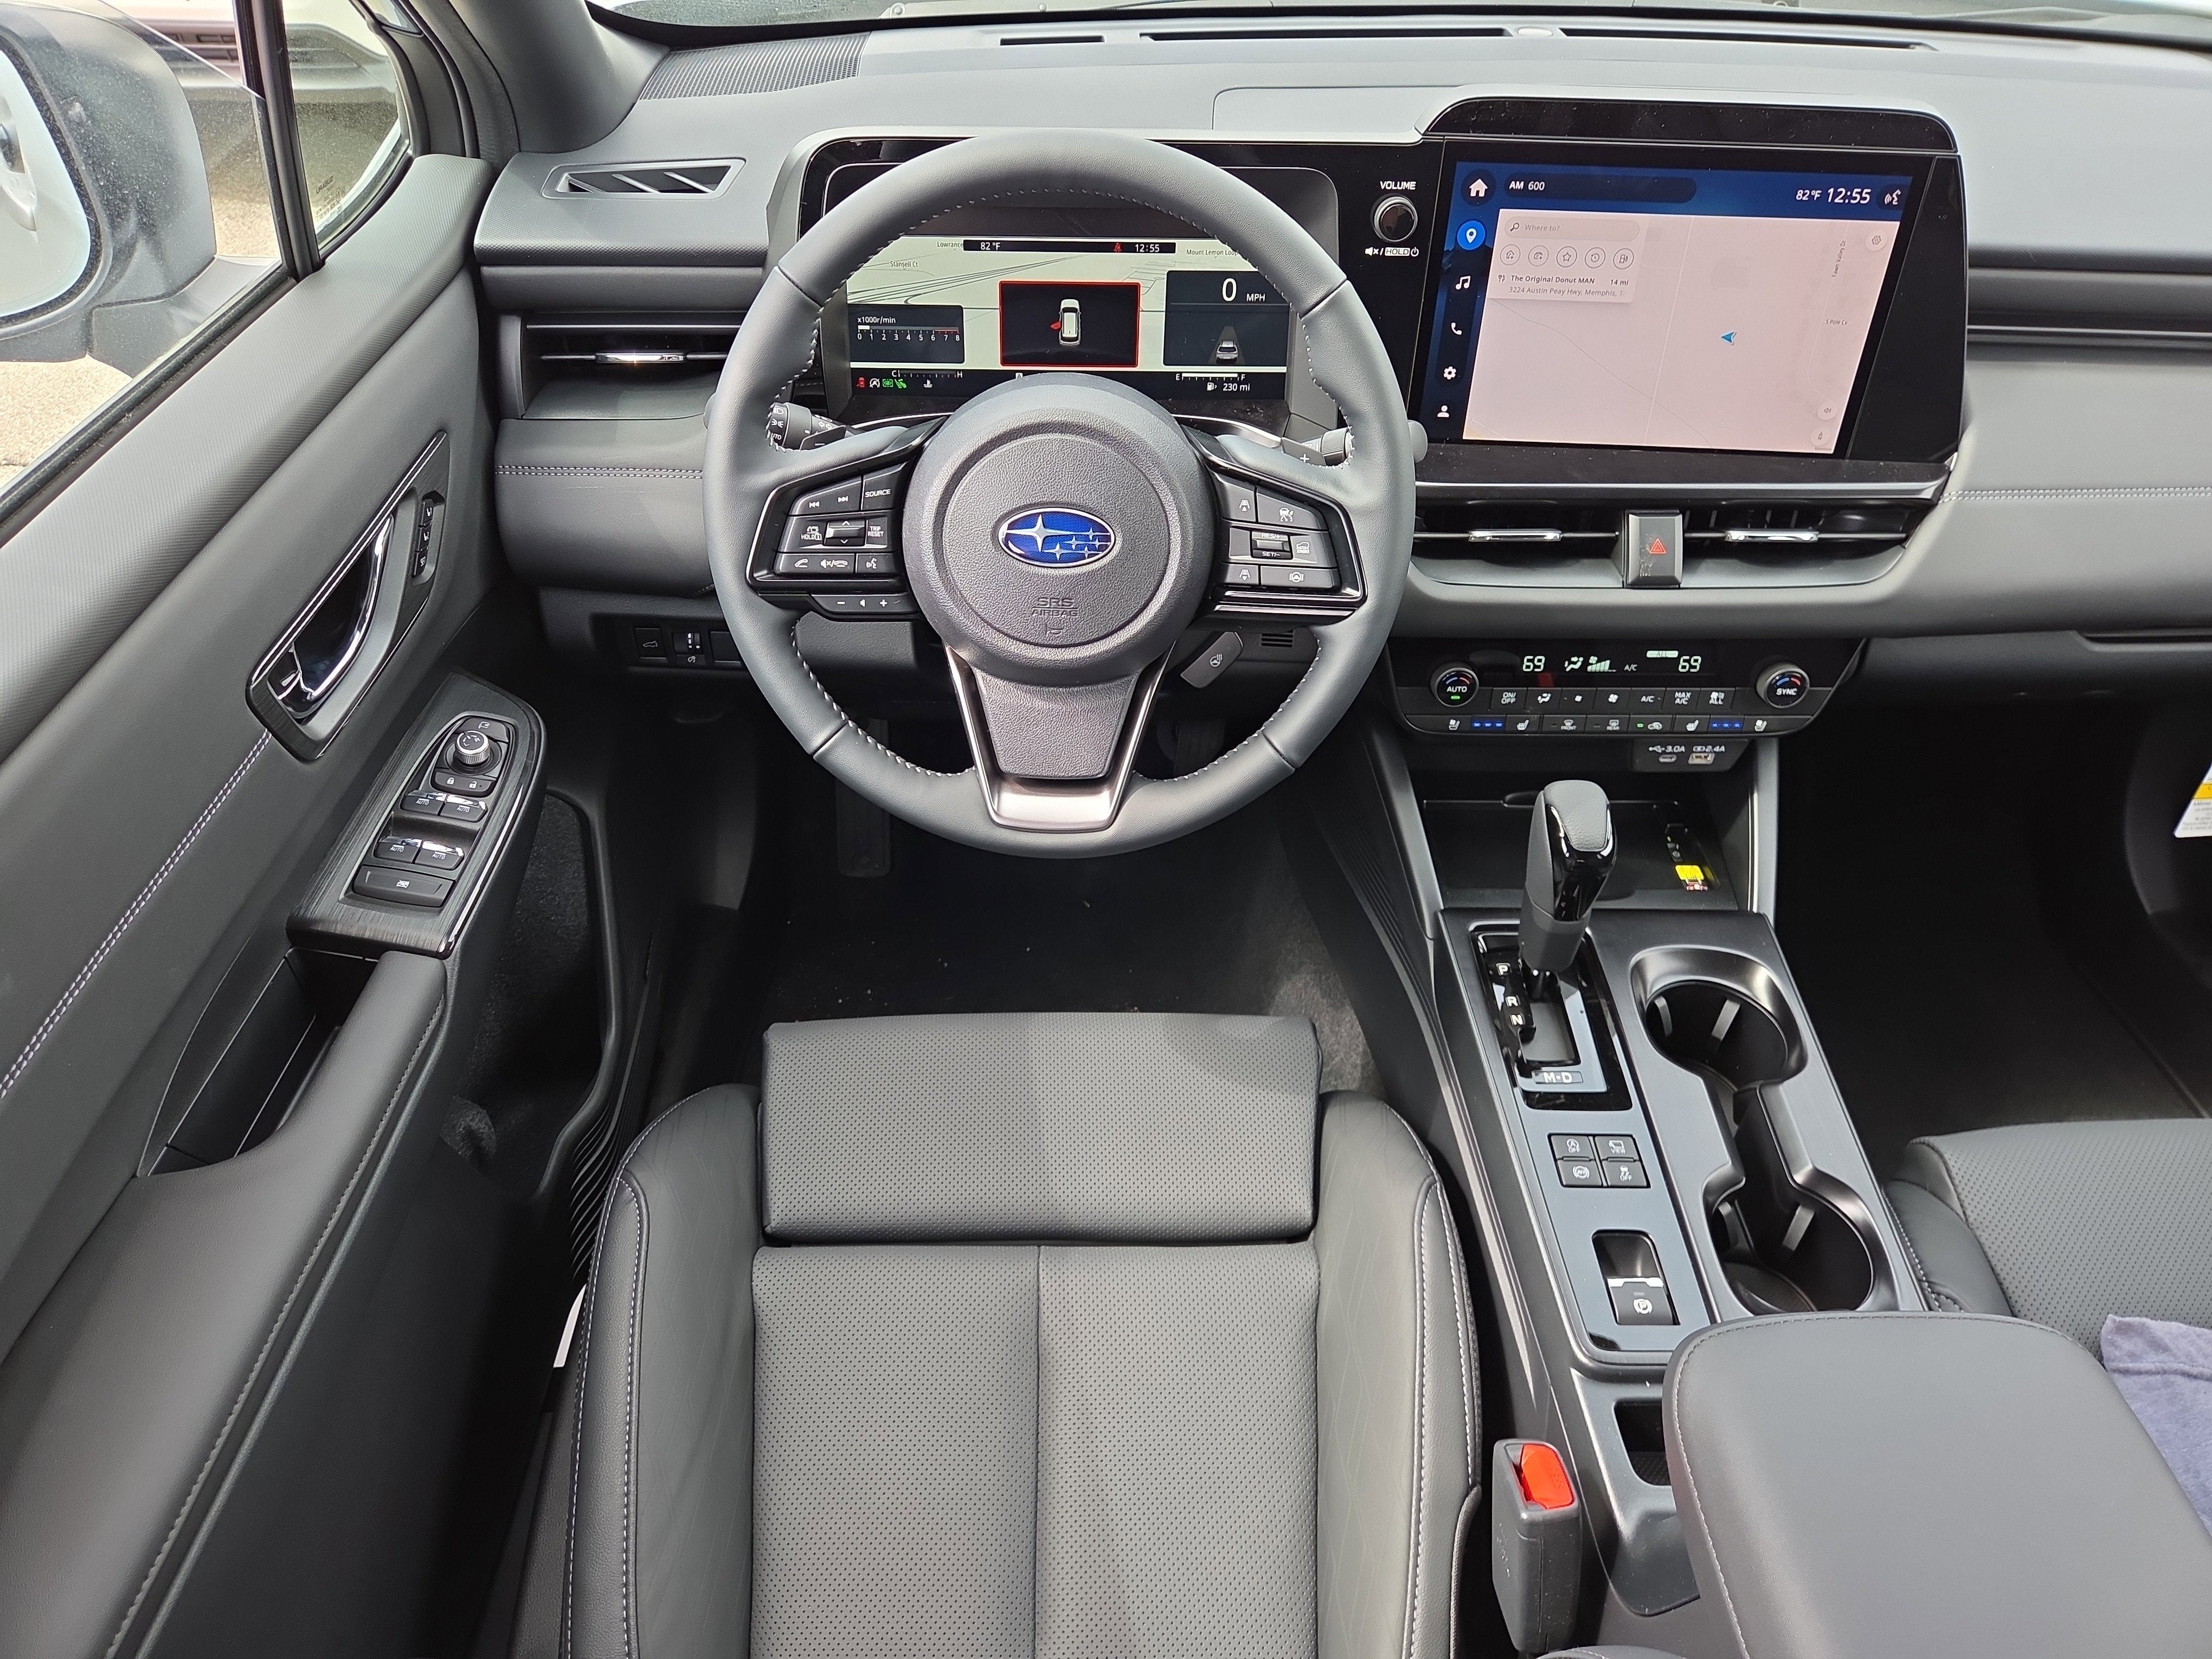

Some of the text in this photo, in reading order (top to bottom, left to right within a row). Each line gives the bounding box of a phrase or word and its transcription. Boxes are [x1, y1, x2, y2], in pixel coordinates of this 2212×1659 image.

[1380, 181, 1416, 190] VOLUME
[1509, 181, 1545, 191] AM 600
[1827, 188, 1872, 204] 12:55
[980, 241, 991, 250] 82
[1135, 244, 1160, 253] 12:55
[1525, 275, 1553, 284] Original
[1221, 278, 1266, 302] 0 MPH
[857, 316, 896, 324] x1000r/min
[1223, 383, 1250, 391] 230 mi
[770, 432, 782, 440] UTO
[865, 488, 891, 498] SOURCE
[1037, 596, 1073, 608] SRS
[1031, 609, 1078, 617] AIRBAG
[1522, 655, 1545, 672] 69
[1624, 664, 1638, 672] A/C
[1678, 655, 1702, 672] 69
[1776, 687, 1798, 696] SYNC
[1498, 964, 1508, 976] P
[1507, 996, 1518, 1007] R
[1512, 1014, 1523, 1026] N
